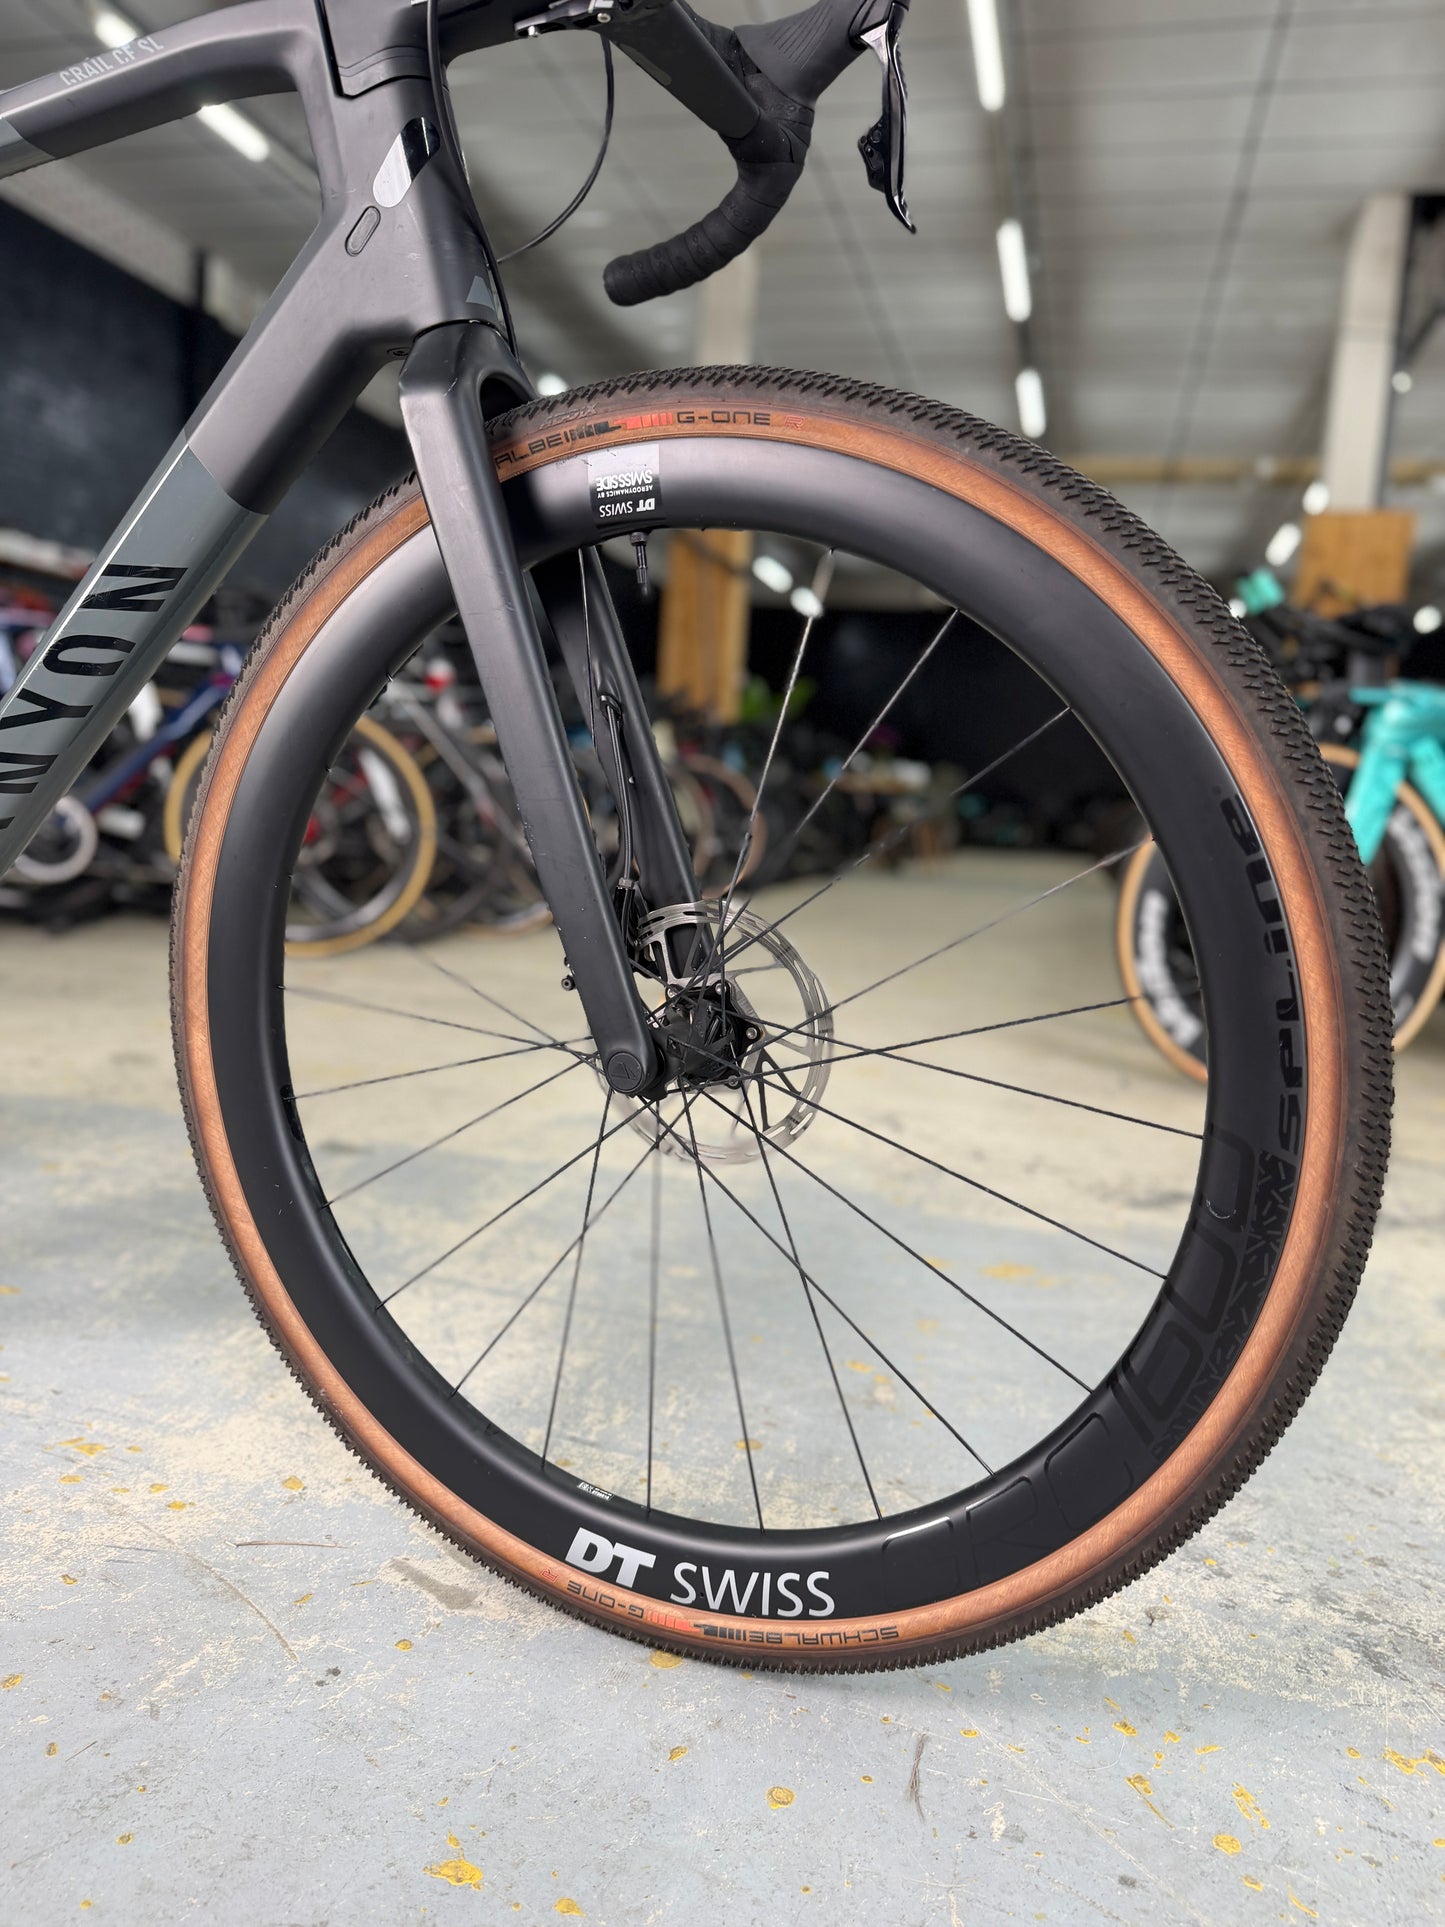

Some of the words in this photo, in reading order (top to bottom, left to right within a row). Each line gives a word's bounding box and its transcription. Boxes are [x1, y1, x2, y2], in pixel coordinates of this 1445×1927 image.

[59, 56, 114, 86] GRAIL
[112, 44, 136, 65] CF
[137, 36, 164, 54] SL
[494, 433, 563, 470] ALBE
[676, 410, 771, 427] G-ONE
[597, 491, 605, 499] BY
[606, 484, 653, 498] AERODYNAMICS
[636, 498, 656, 512] DT
[599, 501, 633, 518] SWISS
[0, 563, 189, 830] NYON
[565, 1527, 657, 1588] DT
[670, 1562, 836, 1618] SWISS
[566, 1579, 645, 1620] G-ONE
[748, 1625, 900, 1646] SCHWALBE
